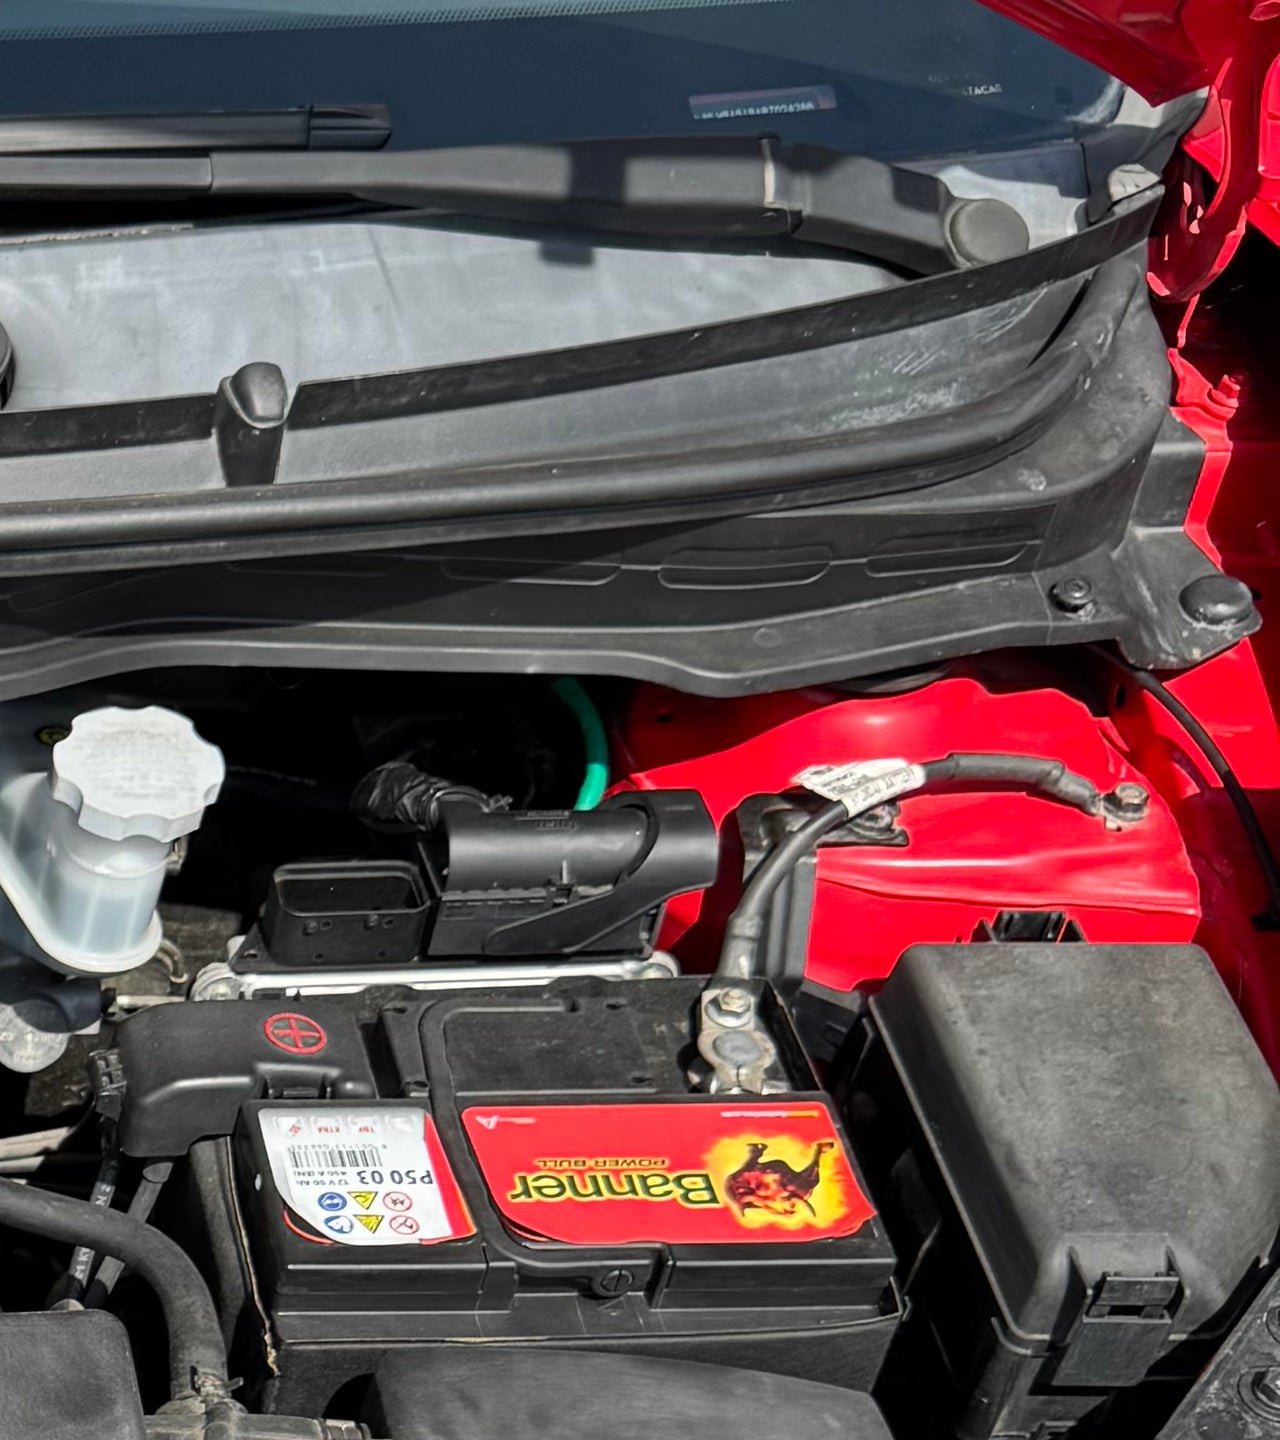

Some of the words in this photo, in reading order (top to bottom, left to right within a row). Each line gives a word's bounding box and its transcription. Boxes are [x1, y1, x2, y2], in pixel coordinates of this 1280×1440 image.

[536, 1159, 587, 1169] BULL
[593, 1159, 666, 1167] POWER
[356, 1169, 384, 1185] 03
[389, 1169, 433, 1185] P50
[509, 1173, 720, 1206] Banner
